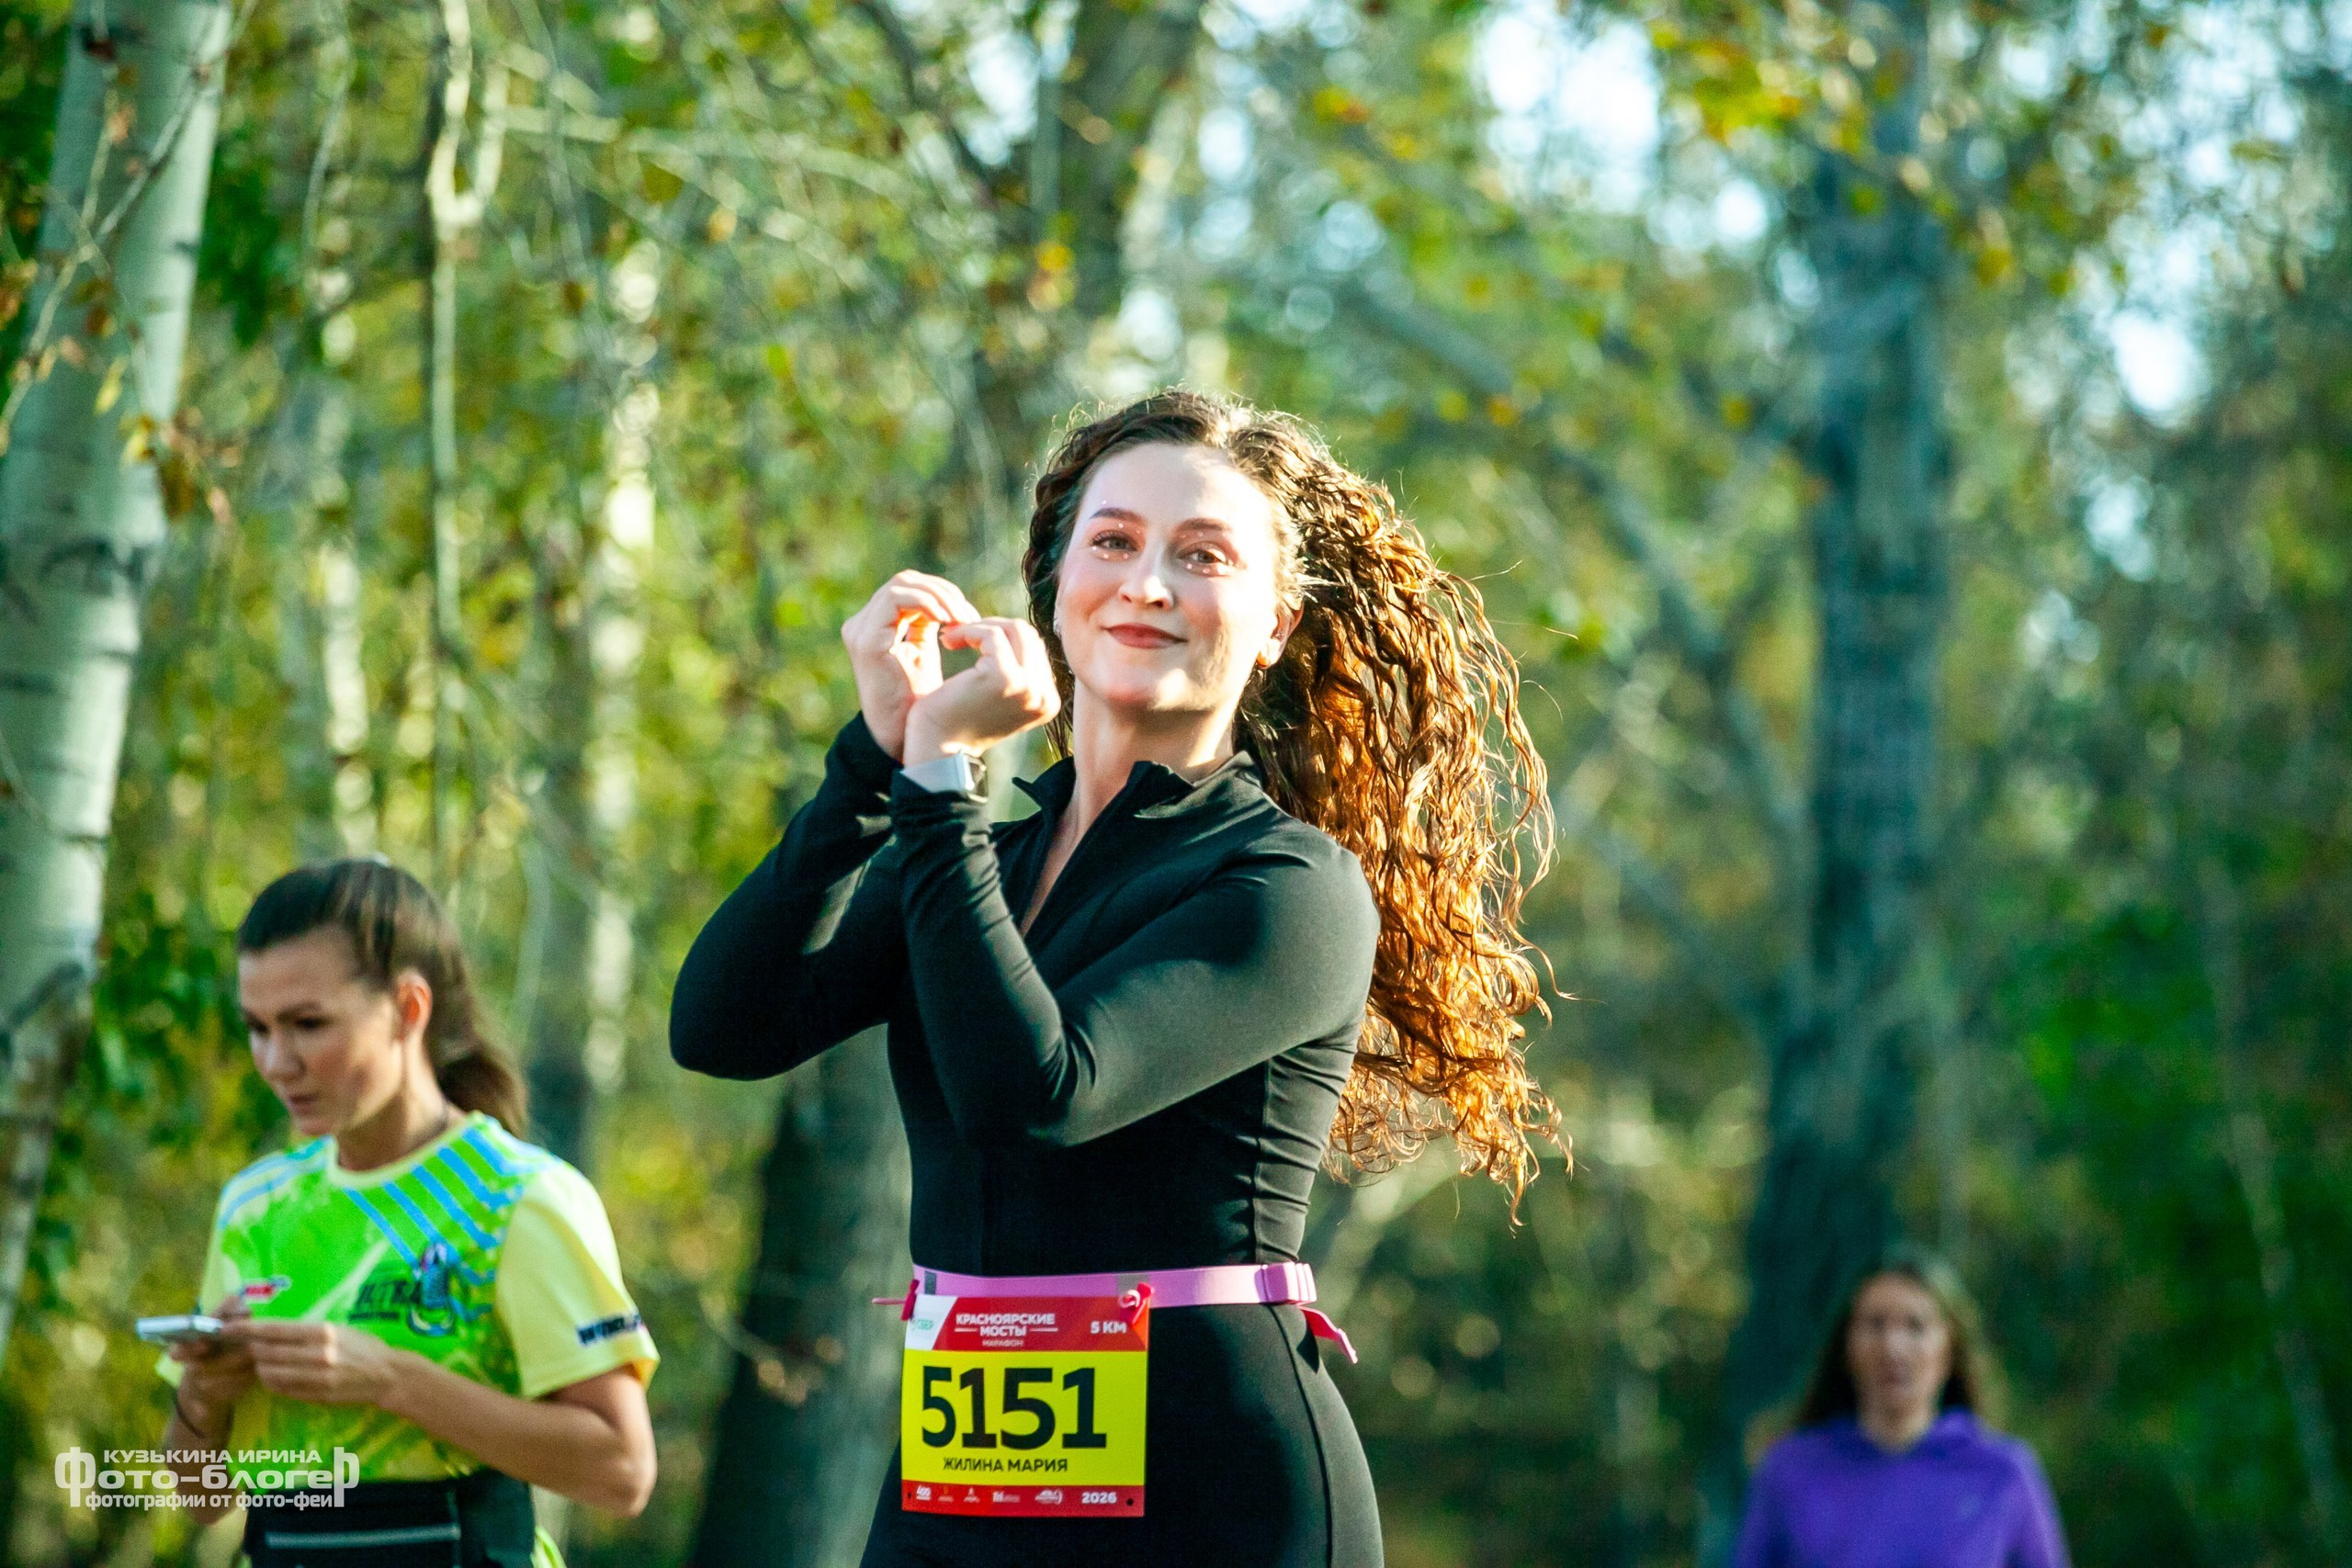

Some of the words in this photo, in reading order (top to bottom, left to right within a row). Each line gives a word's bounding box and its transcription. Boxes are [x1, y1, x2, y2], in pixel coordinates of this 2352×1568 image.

[956, 1314, 1056, 1325] КРАСНОЯРСКИЕ
[979, 1325, 1027, 1337] МОСТЫ
[1091, 1321, 1100, 1334] 5
[1102, 1321, 1127, 1334] КМ
[982, 1339, 1024, 1348] МАРАФОН
[922, 1365, 1107, 1450] 5151
[944, 1457, 1003, 1472] ЖИЛИНА
[1008, 1458, 1068, 1472] МАРИЯ
[1081, 1492, 1117, 1504] 2026
